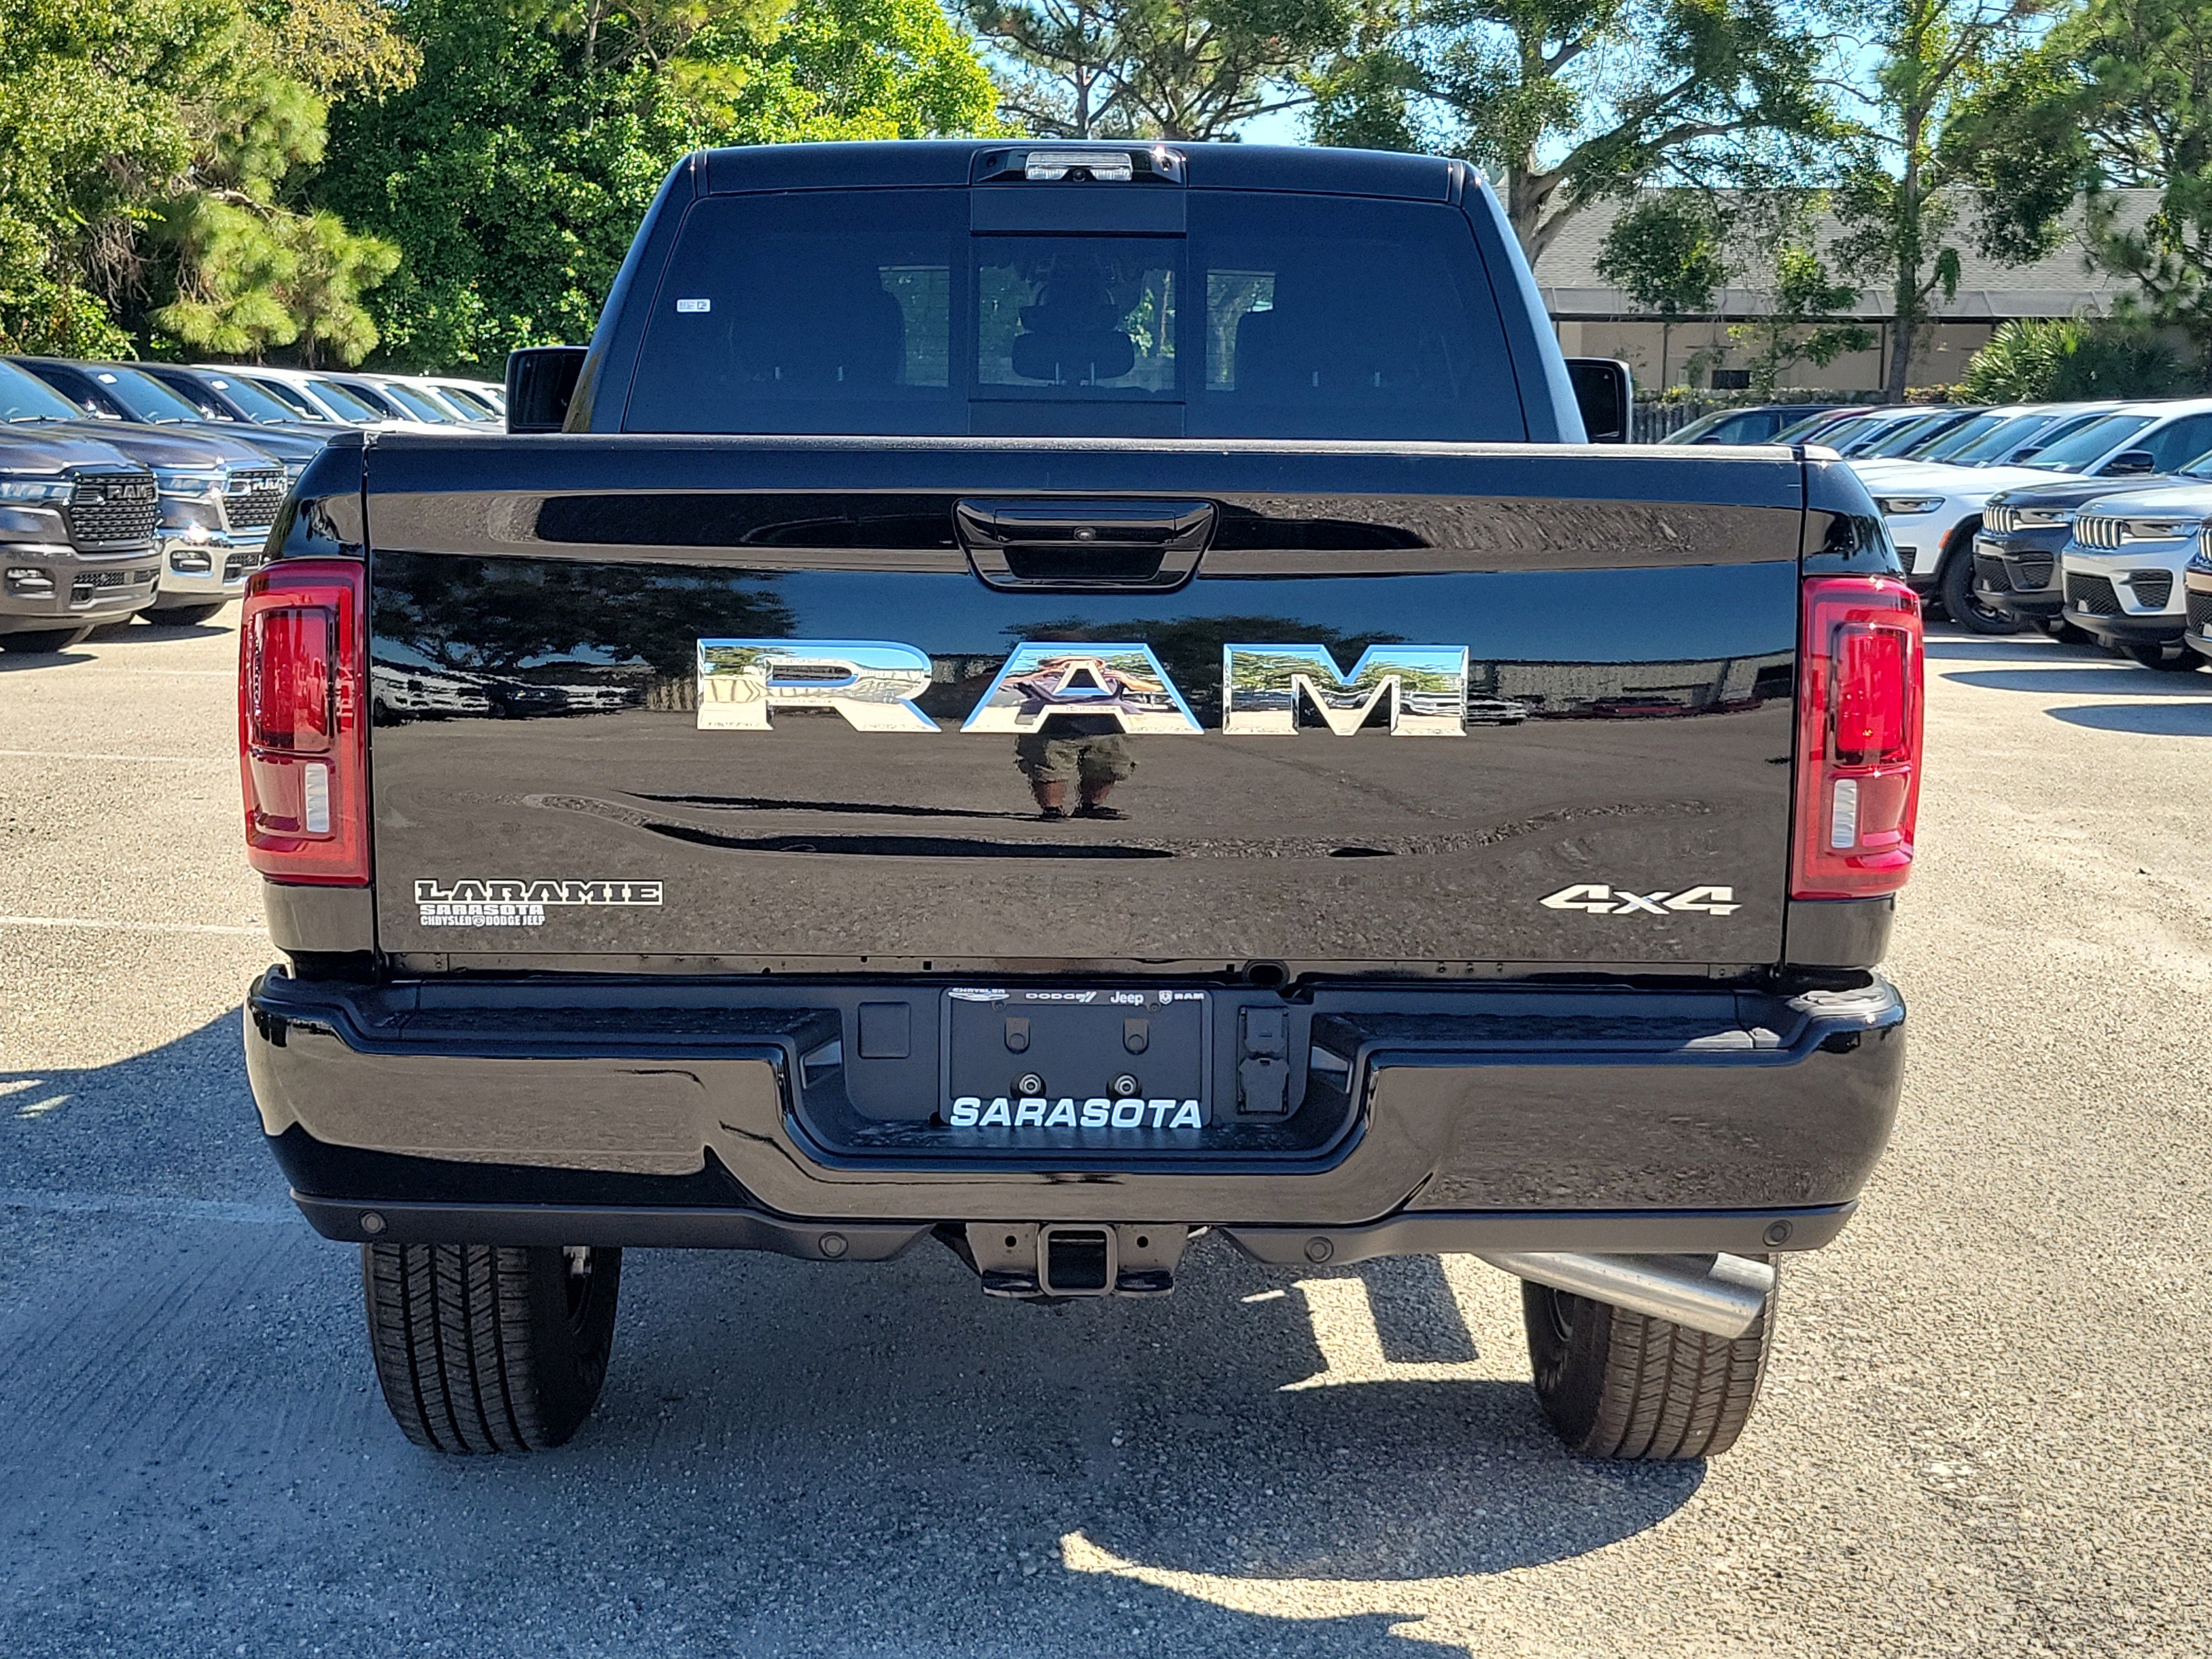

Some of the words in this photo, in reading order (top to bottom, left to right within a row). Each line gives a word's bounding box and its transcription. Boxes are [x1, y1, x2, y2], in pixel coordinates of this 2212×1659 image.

[697, 638, 1469, 737] RAM
[415, 880, 663, 905] LARAMIE
[1539, 884, 1742, 916] 4x4
[420, 905, 545, 915] SARASOTA
[420, 916, 472, 926] CHRYSLER
[486, 916, 521, 926] DODGE
[522, 916, 545, 926] JEEP
[1110, 991, 1144, 1006] Jeep
[950, 1097, 1202, 1128] SARASOTA
